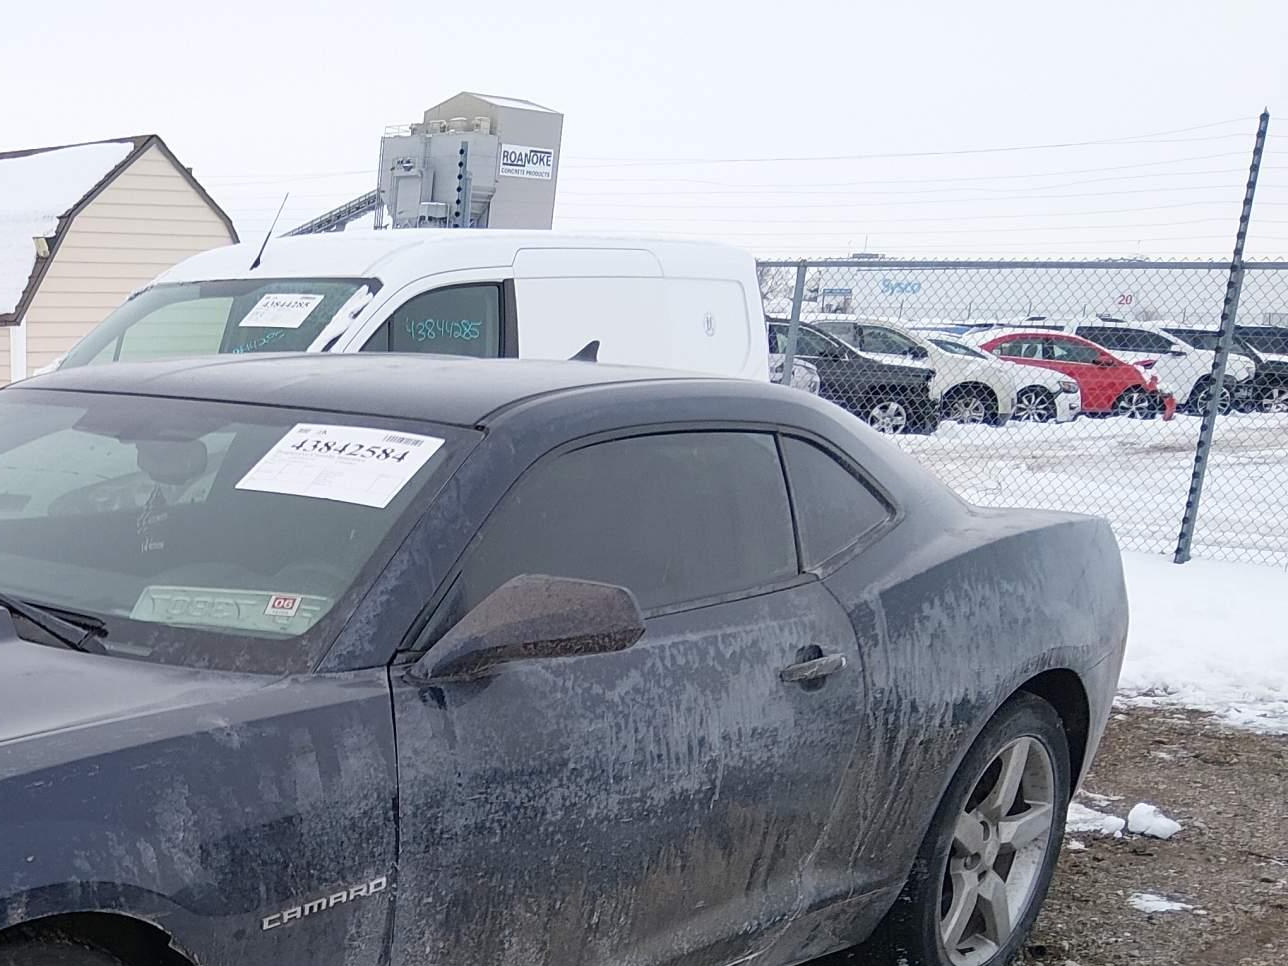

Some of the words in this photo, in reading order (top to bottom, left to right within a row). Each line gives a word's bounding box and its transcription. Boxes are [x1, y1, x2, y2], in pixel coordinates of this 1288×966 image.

[502, 150, 552, 167] ROANOKE
[1118, 294, 1133, 305] 20
[406, 316, 482, 341] 43844285
[291, 438, 410, 463] 43842584
[262, 876, 387, 931] CAMARO
